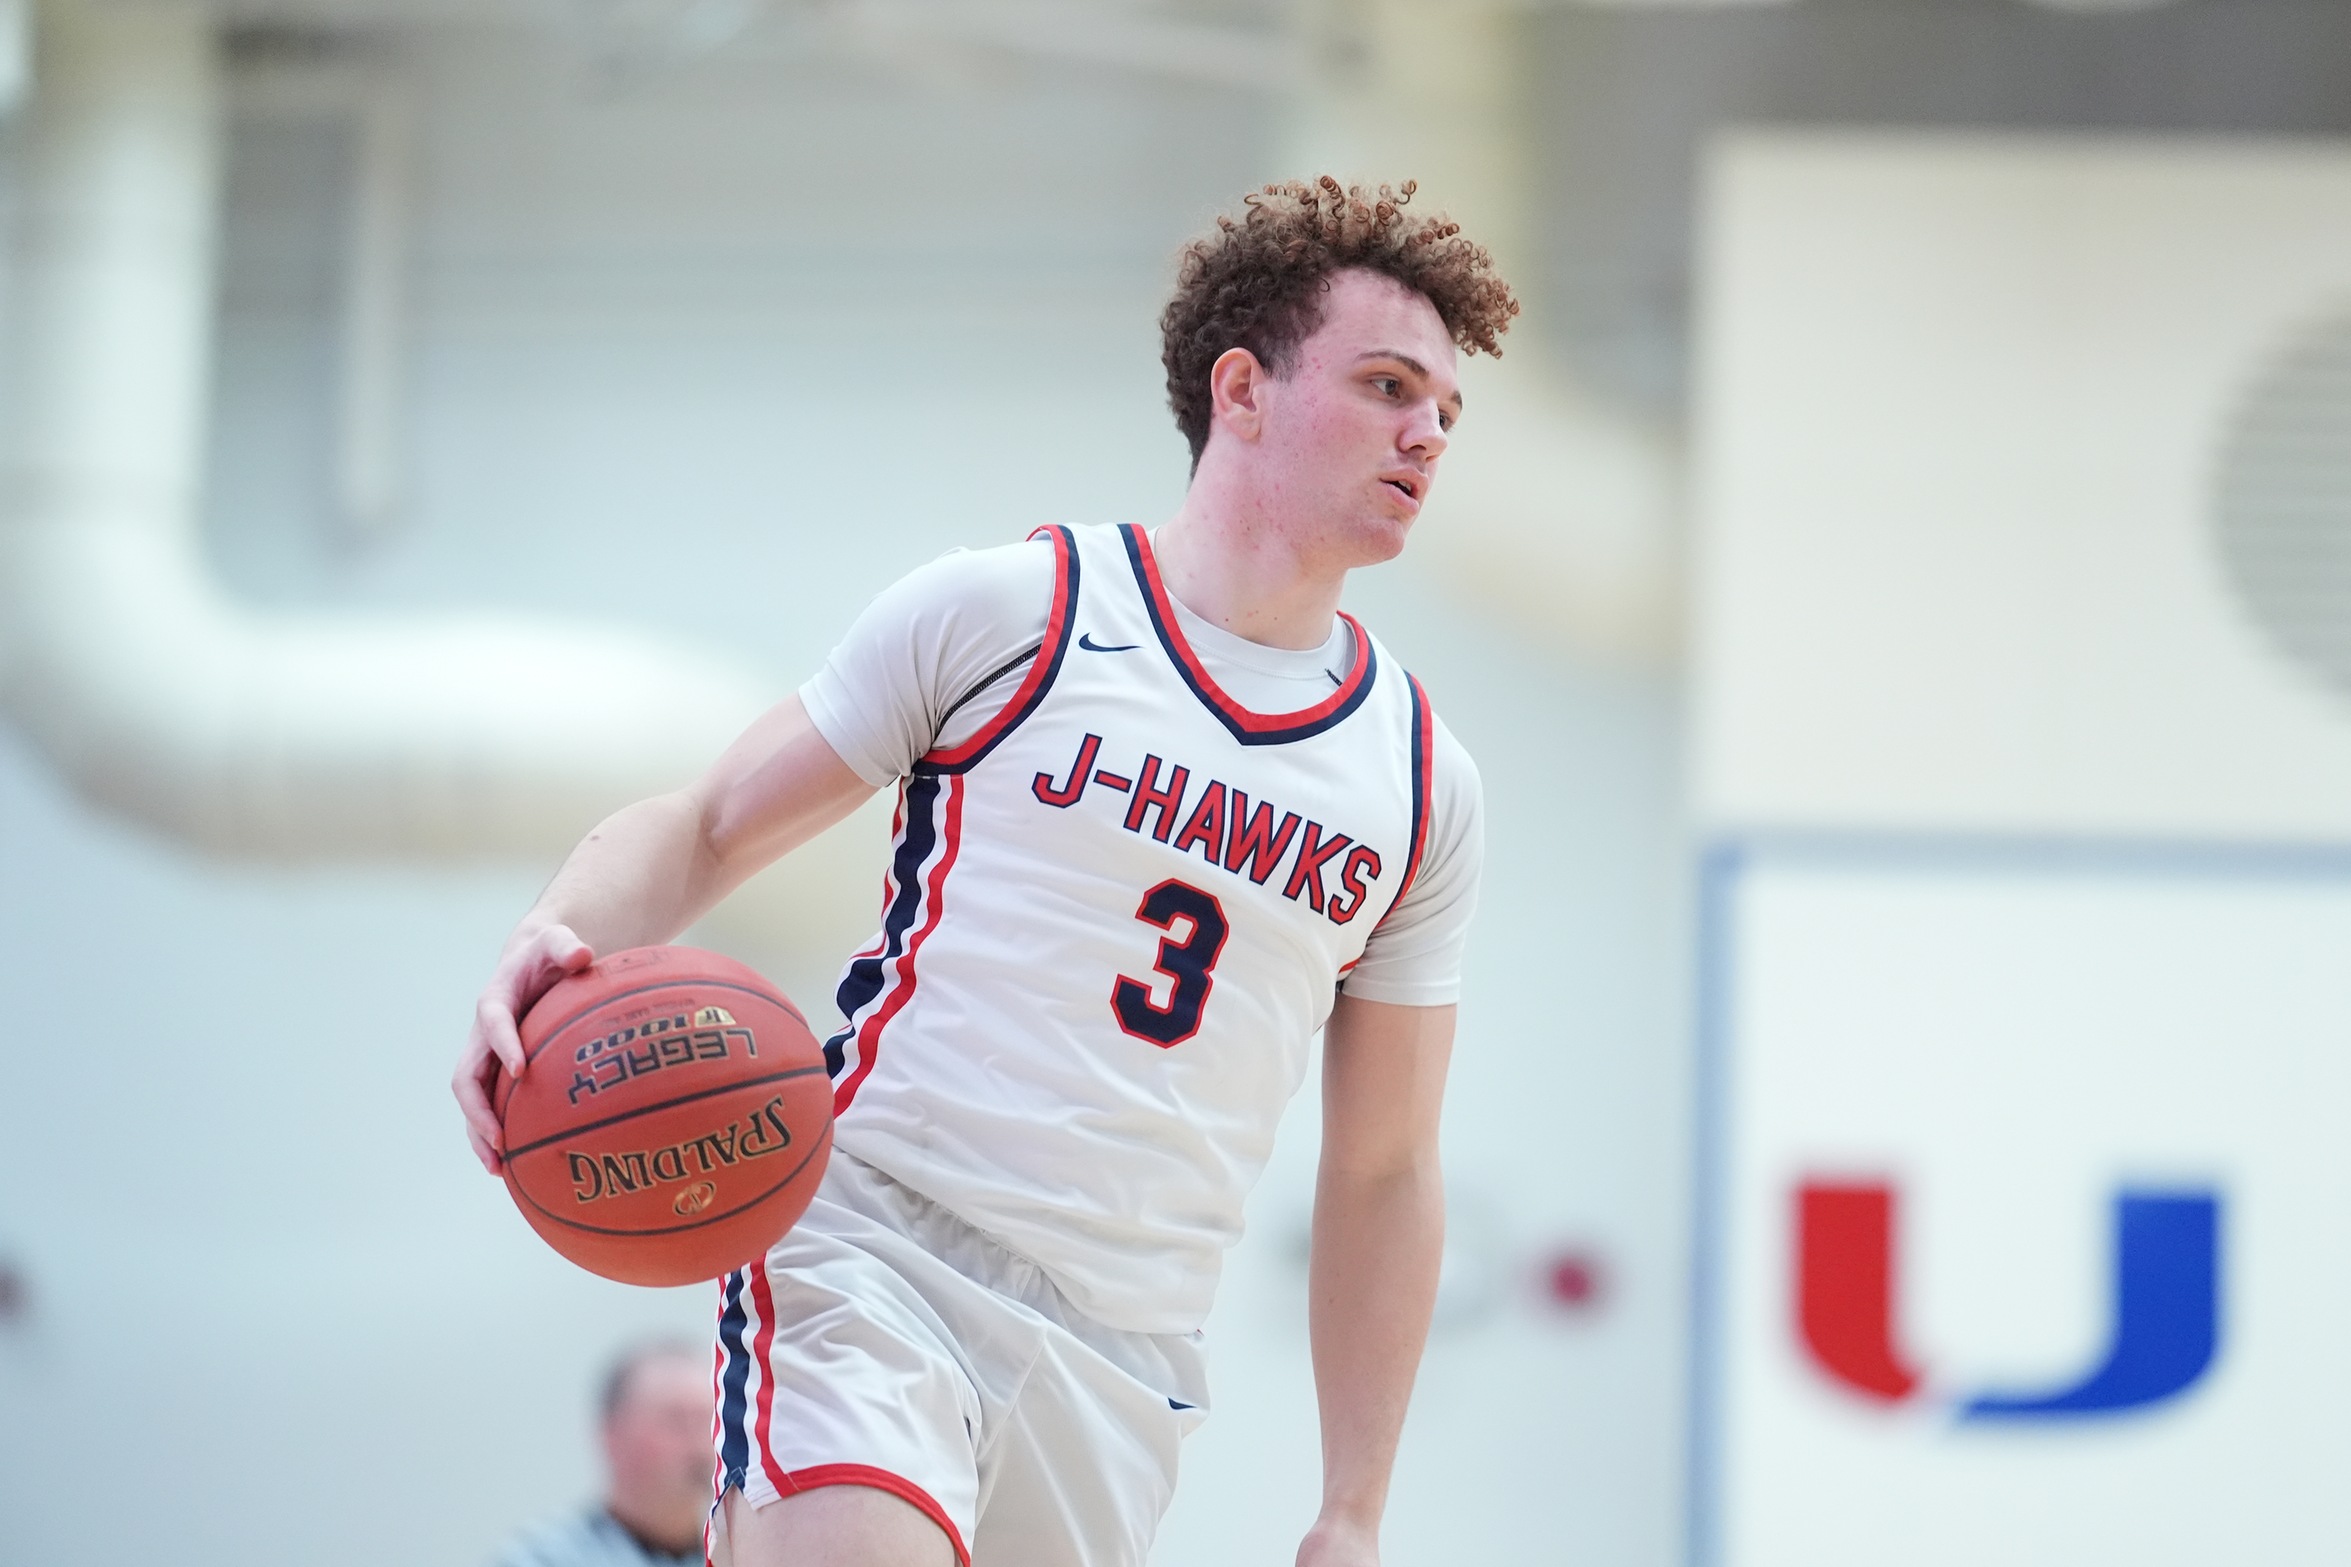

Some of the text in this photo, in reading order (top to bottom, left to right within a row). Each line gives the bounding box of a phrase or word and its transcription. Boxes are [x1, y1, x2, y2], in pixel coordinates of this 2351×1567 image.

[1031, 732, 1383, 926] J-HAWKS
[1109, 877, 1230, 1049] 3
[567, 1028, 758, 1107] LEGACY
[574, 1012, 690, 1063] 1000
[567, 1094, 793, 1204] SPALDING
[1795, 1184, 2223, 1418] U
